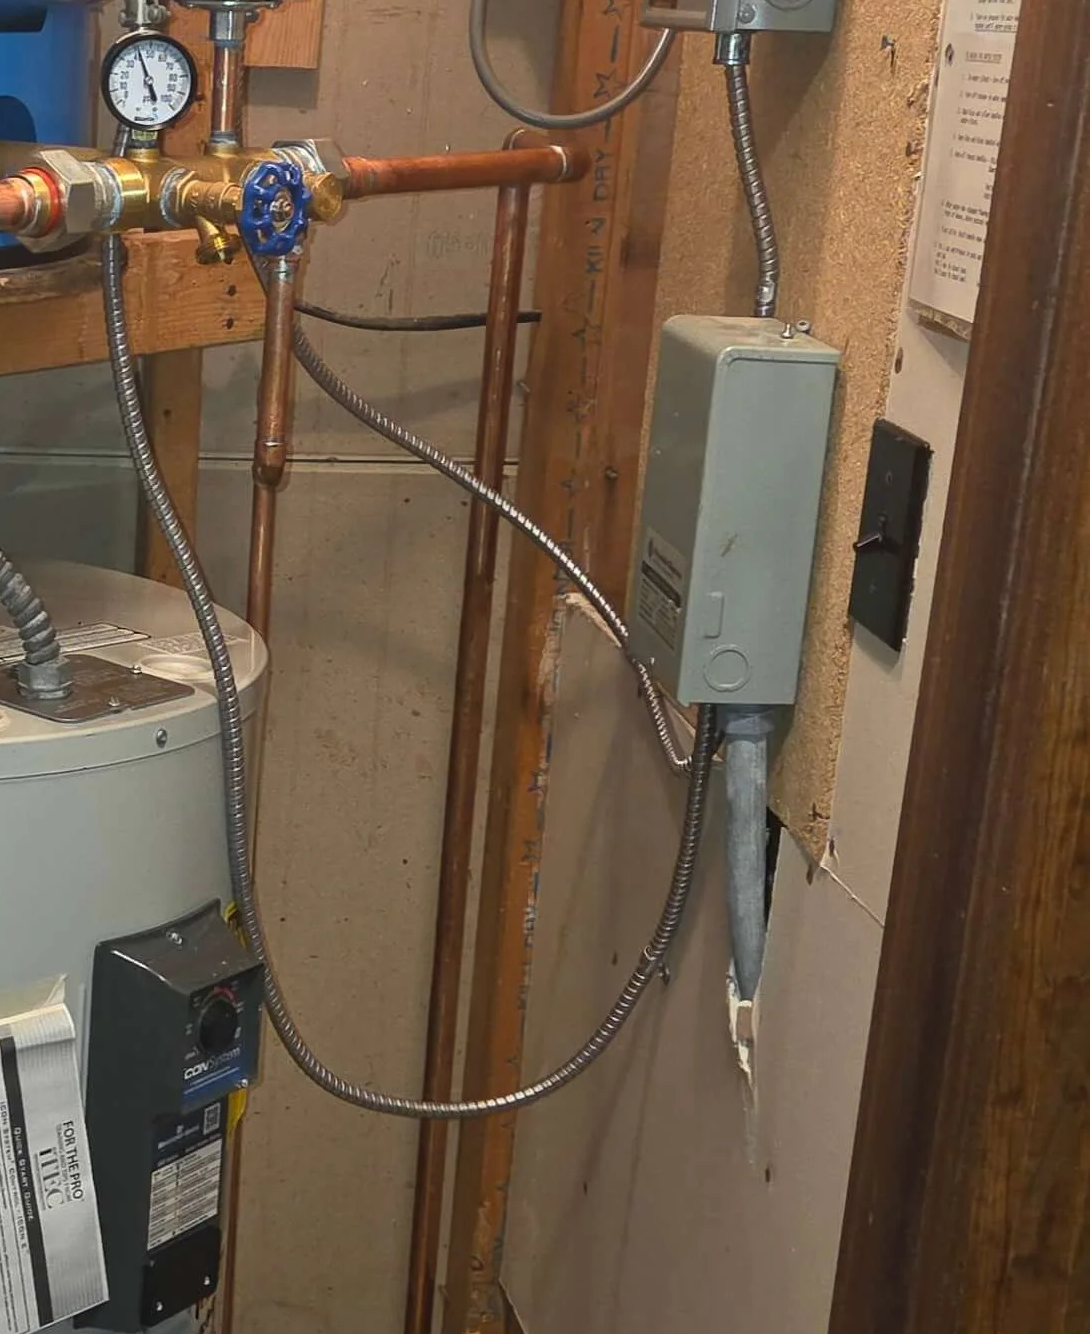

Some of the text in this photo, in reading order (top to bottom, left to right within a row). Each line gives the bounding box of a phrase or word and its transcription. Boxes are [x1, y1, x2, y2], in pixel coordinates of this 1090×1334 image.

[61, 1121, 84, 1200] FOR THE PRO
